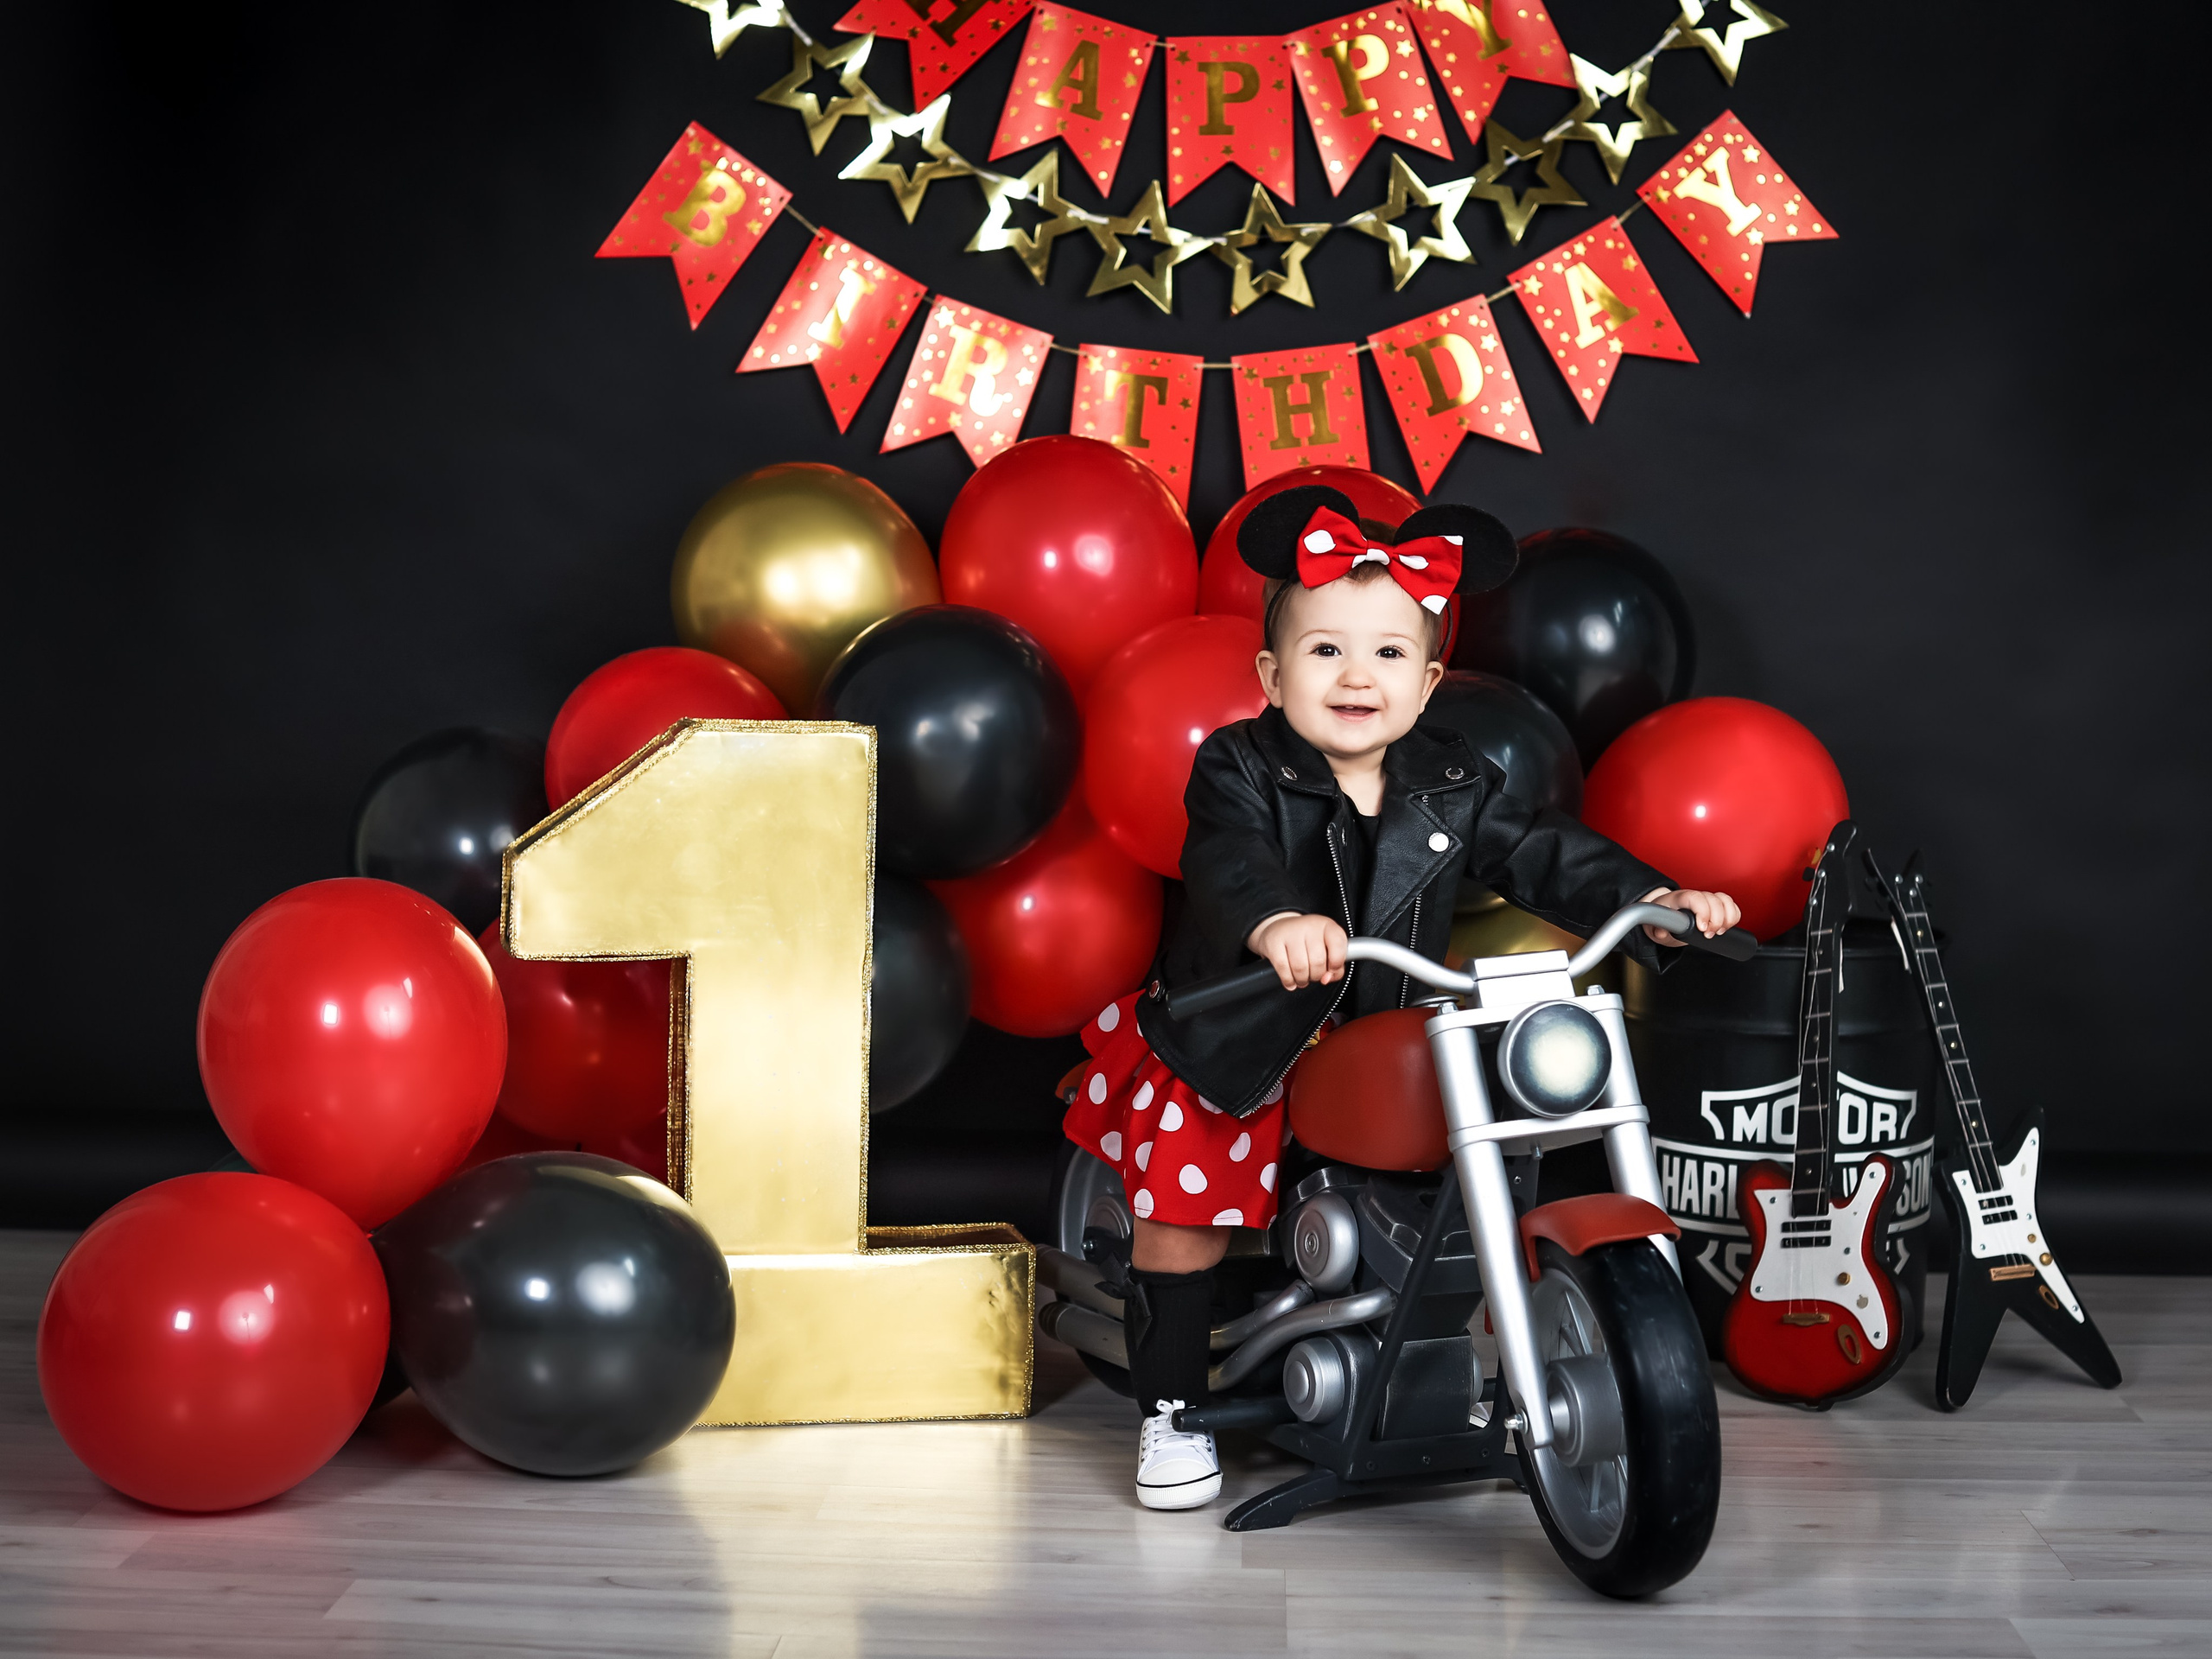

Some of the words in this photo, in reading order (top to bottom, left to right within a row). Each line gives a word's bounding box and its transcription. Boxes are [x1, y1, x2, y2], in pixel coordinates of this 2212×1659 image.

[662, 145, 1763, 451] BIRTHDAY
[501, 717, 1036, 1427] 1
[1732, 1091, 1898, 1146] MOOR
